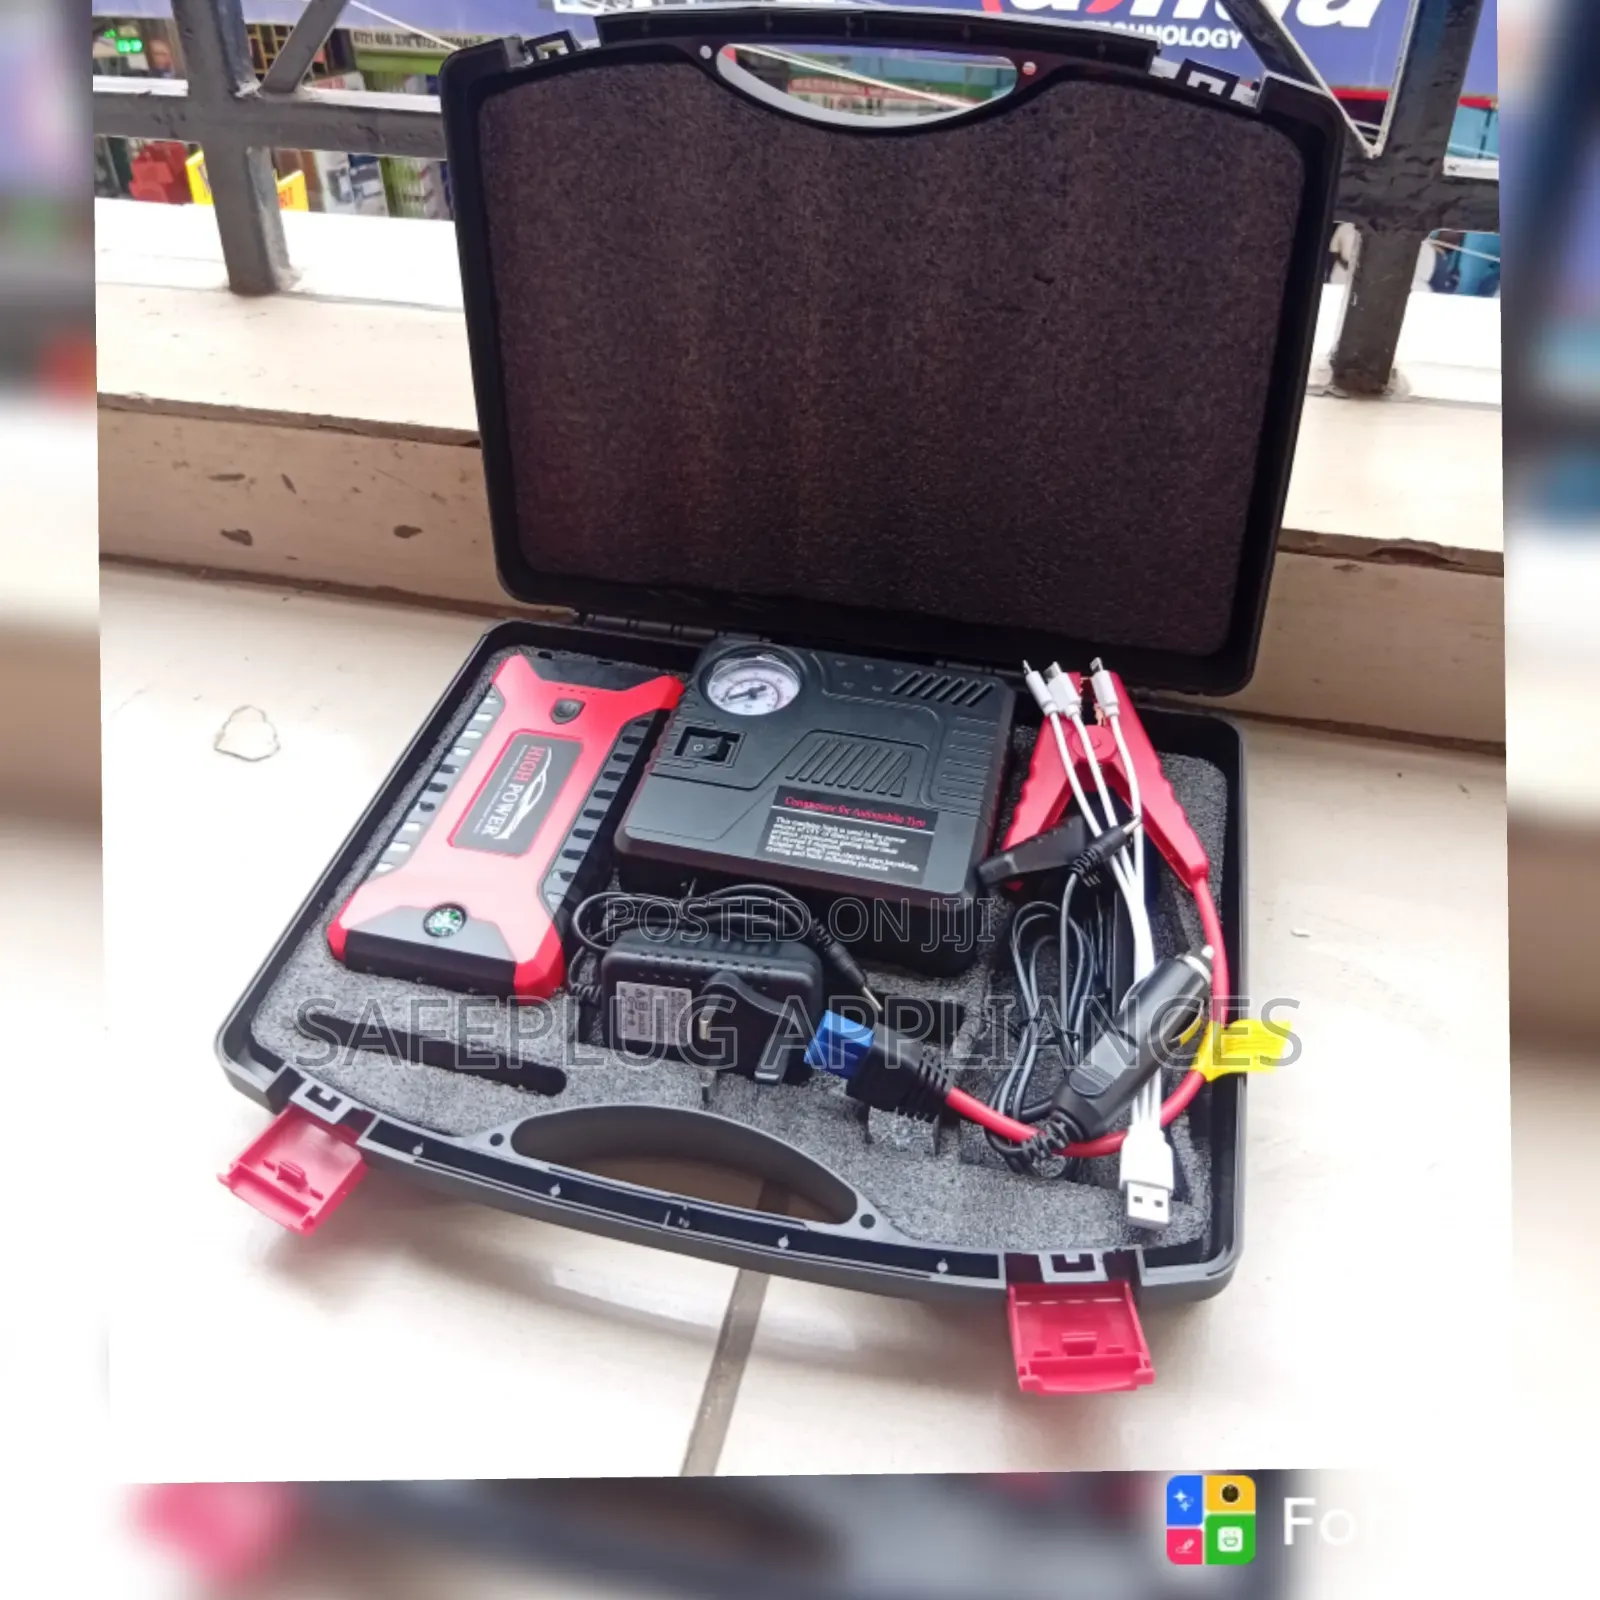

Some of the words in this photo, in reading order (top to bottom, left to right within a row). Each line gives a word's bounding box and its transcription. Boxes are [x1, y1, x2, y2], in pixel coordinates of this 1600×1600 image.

[1083, 20, 1243, 49] HNOLOGY
[513, 745, 547, 782] HIGH
[481, 782, 525, 837] POWER
